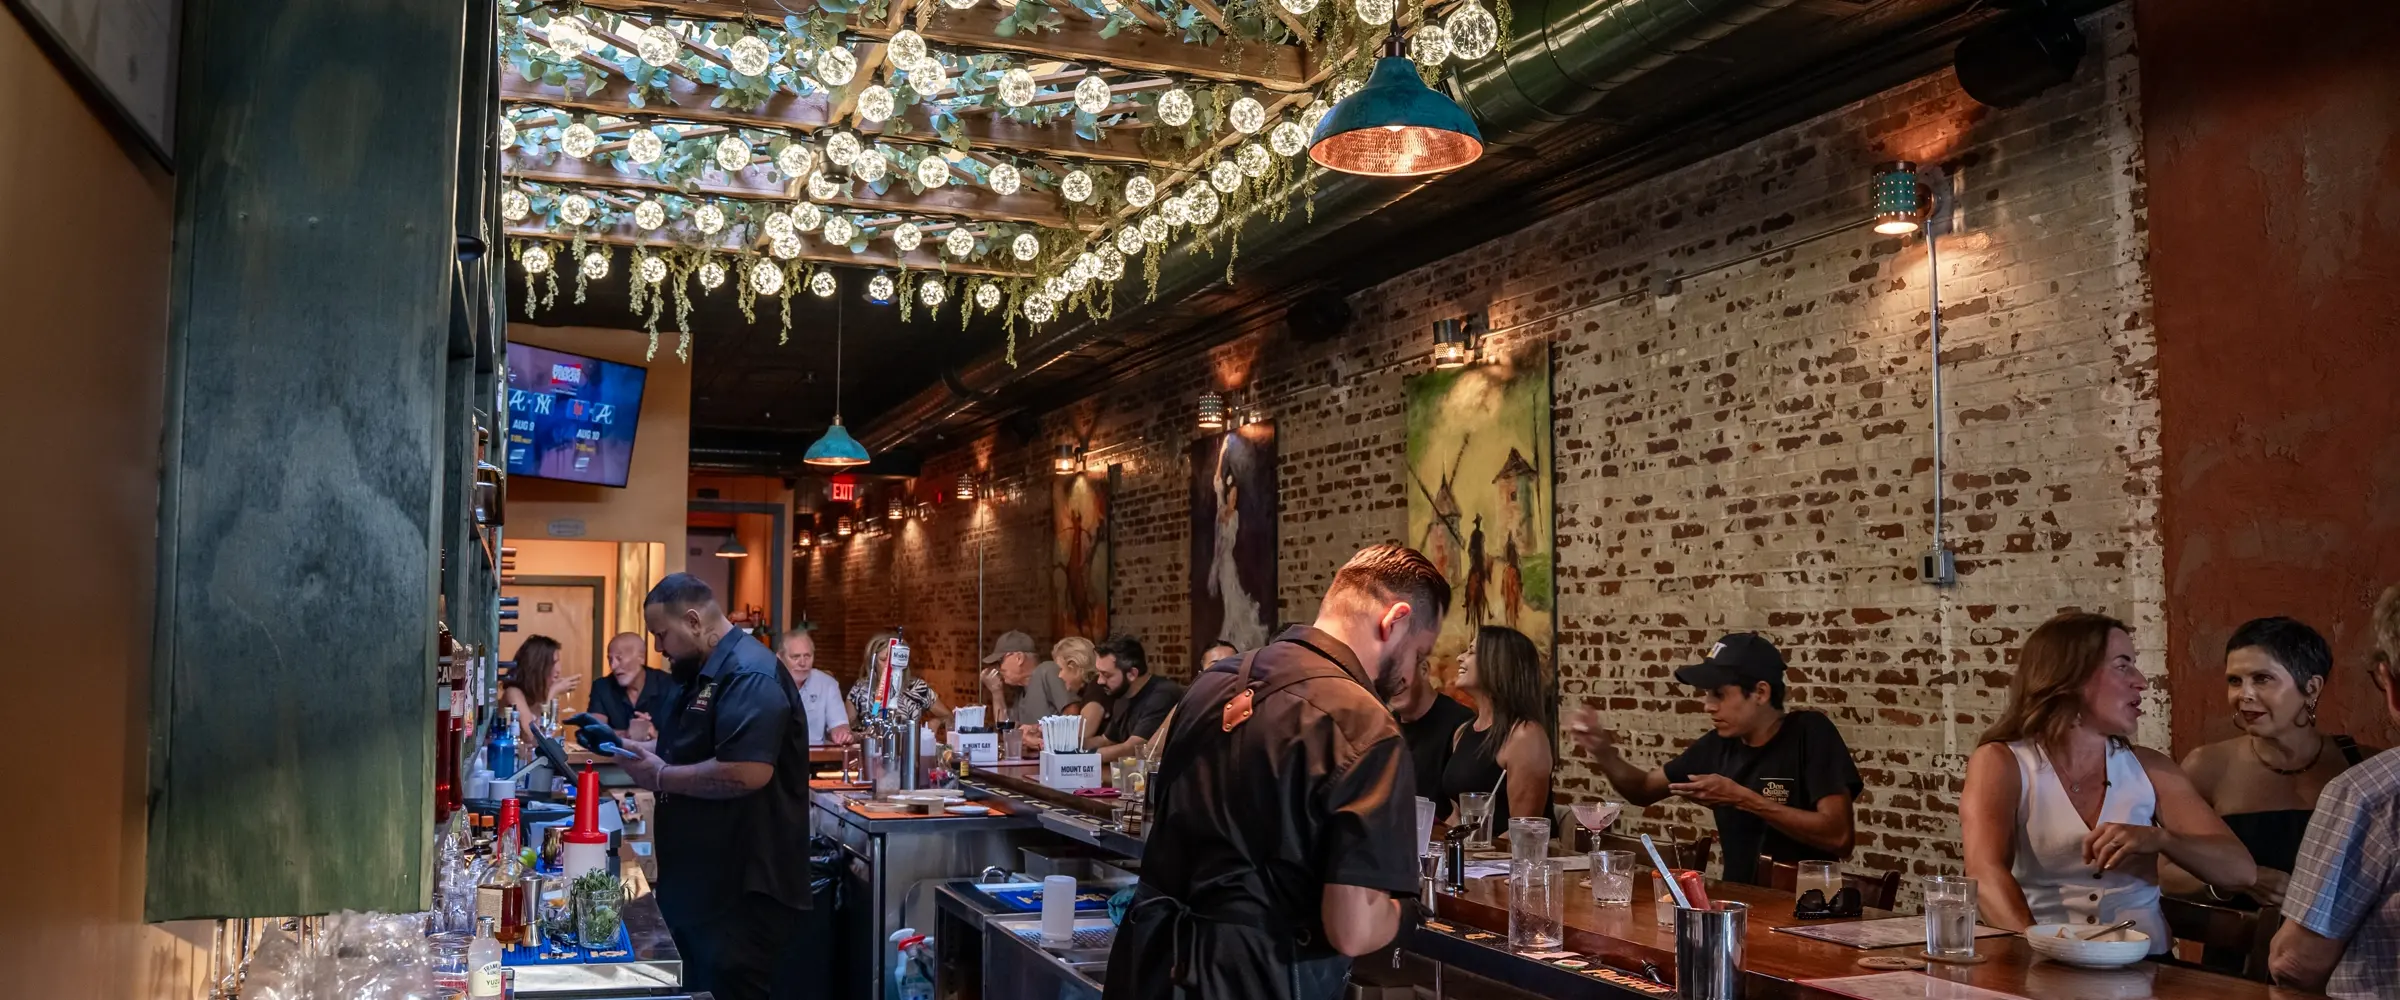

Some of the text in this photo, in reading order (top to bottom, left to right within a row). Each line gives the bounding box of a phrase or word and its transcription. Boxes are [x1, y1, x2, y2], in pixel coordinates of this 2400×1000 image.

[512, 419, 529, 430] AUG
[576, 429, 591, 440] AUG
[833, 484, 854, 500] EXIT
[1767, 781, 1784, 789] Don
